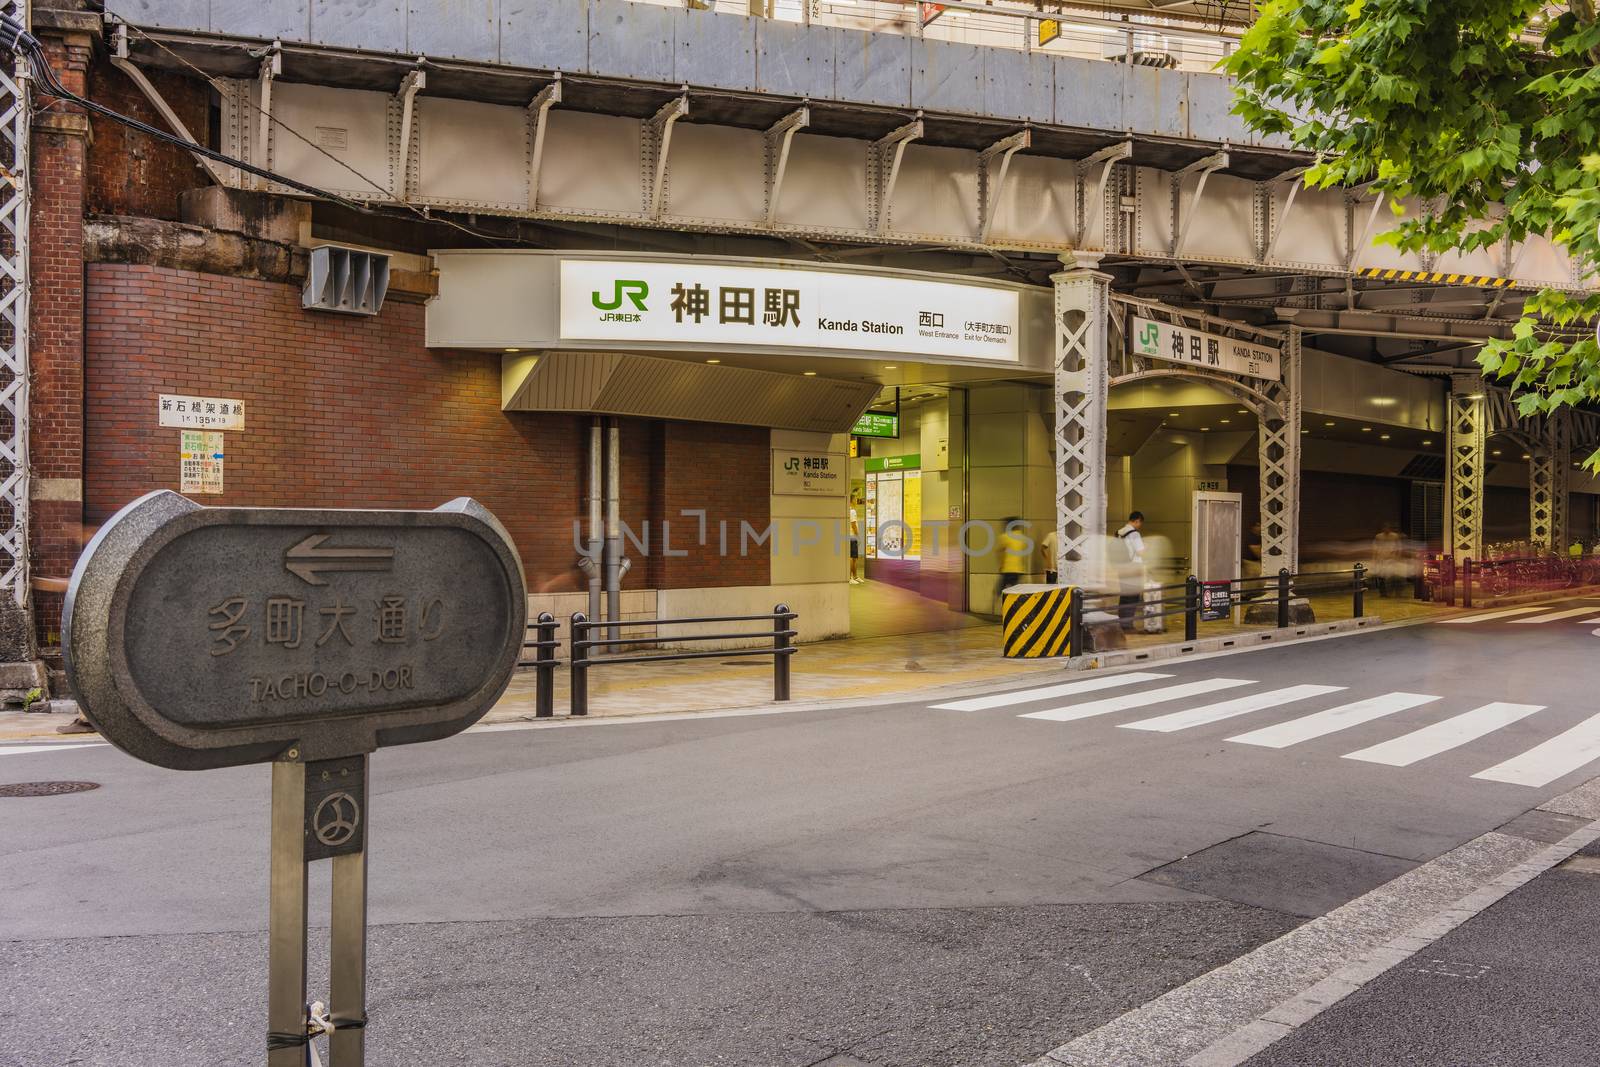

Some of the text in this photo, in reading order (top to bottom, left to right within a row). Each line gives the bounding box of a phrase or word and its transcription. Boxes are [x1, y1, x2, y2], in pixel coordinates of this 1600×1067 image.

[592, 279, 649, 312] JR
[670, 282, 801, 328] 神田駅
[599, 313, 642, 322] JR東日本
[919, 311, 944, 328] 西口
[818, 318, 904, 335] Kanda Station
[918, 329, 959, 340] West Entrance
[1140, 323, 1159, 347] JR
[964, 333, 975, 341] Exit
[975, 334, 983, 342] for
[1172, 330, 1220, 366] 神田駅
[1233, 345, 1273, 363] KANDA STATION
[162, 399, 243, 416] 新石橋架道橋
[784, 457, 800, 471] JR
[803, 456, 829, 470] 神田駅
[803, 471, 820, 479] Kanda
[208, 595, 448, 657] 多町大通り
[251, 664, 416, 701] TACHO-O-DORI
